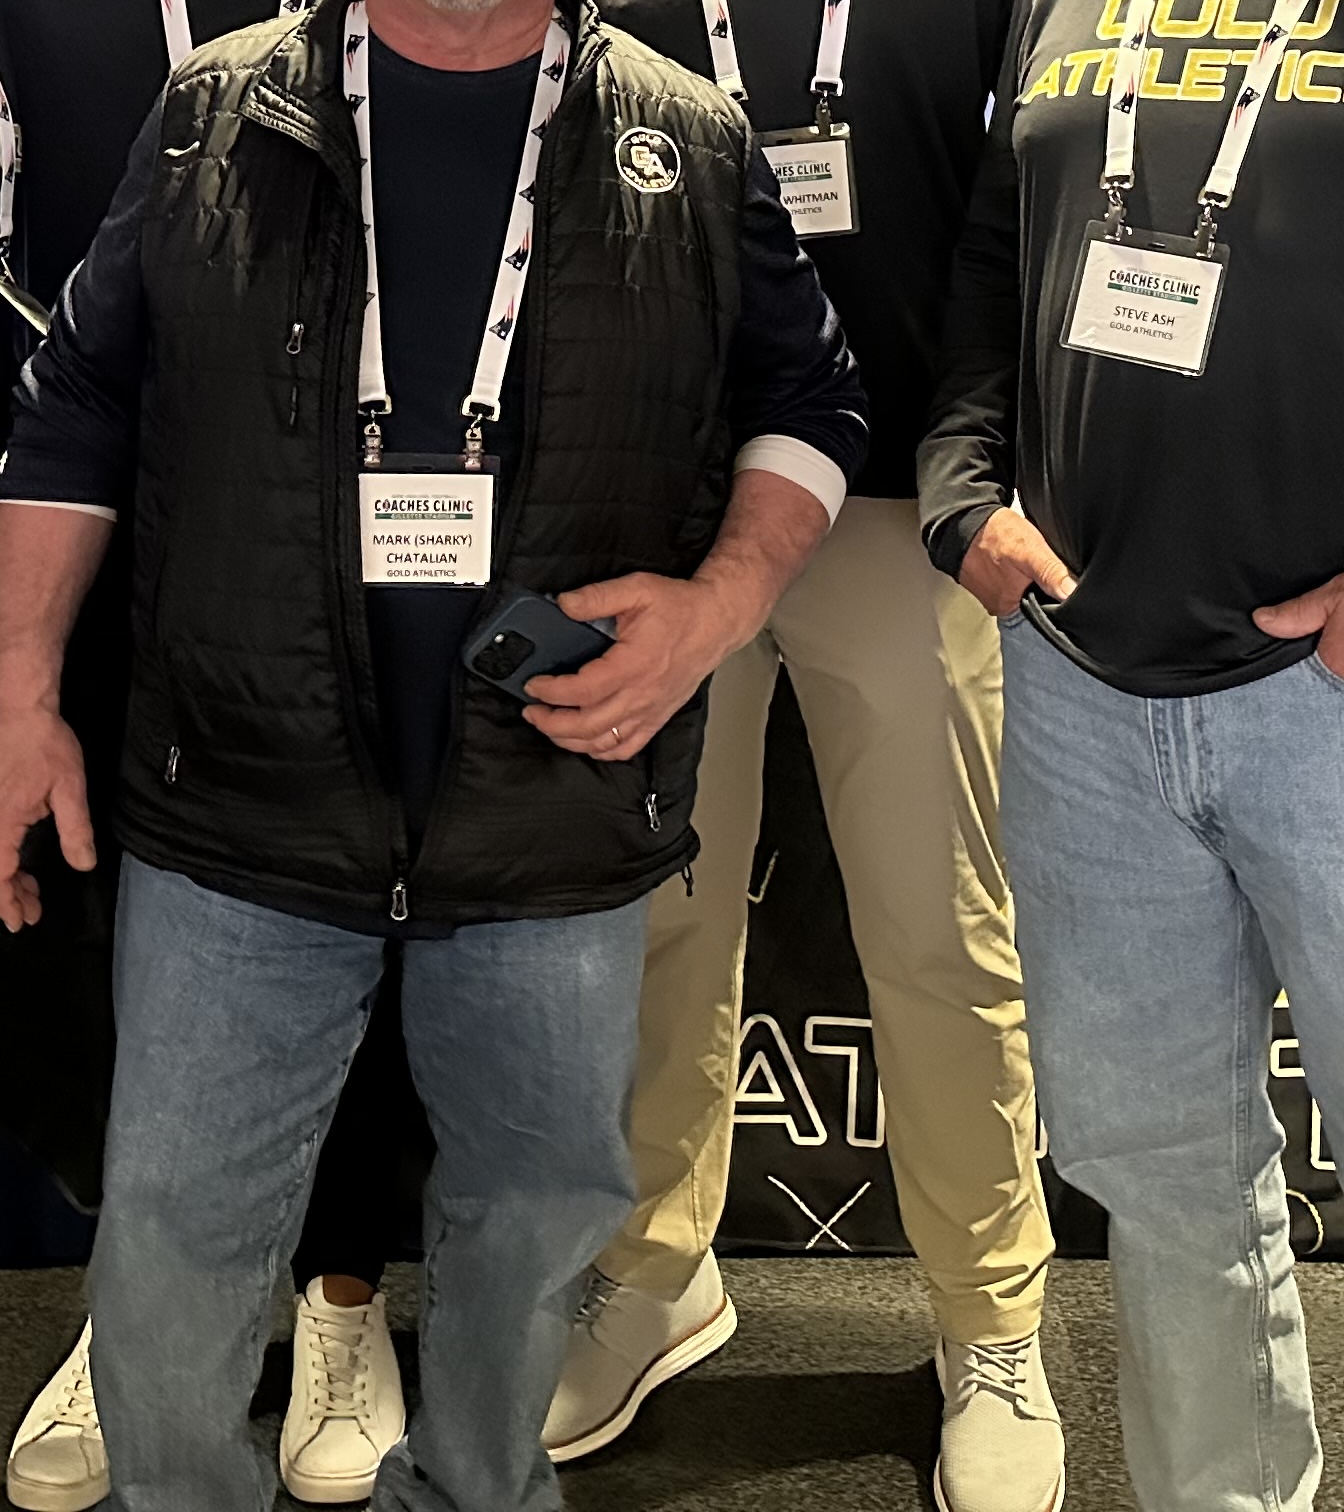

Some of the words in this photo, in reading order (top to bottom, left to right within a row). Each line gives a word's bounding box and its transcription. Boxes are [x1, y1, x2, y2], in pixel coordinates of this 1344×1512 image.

[797, 162, 831, 175] CLINIC
[783, 191, 839, 206] WHITMAN
[1109, 269, 1160, 290] COACHES
[1163, 279, 1201, 297] CLINIC
[1113, 305, 1149, 322] STEVE
[1151, 312, 1176, 327] ASH
[1109, 321, 1132, 332] GOLD
[374, 499, 429, 512] COACHES
[433, 500, 473, 512] CLINIC
[372, 534, 411, 546] MARK
[414, 534, 472, 548] (SHARKY)
[386, 552, 457, 564] CHATALIAN
